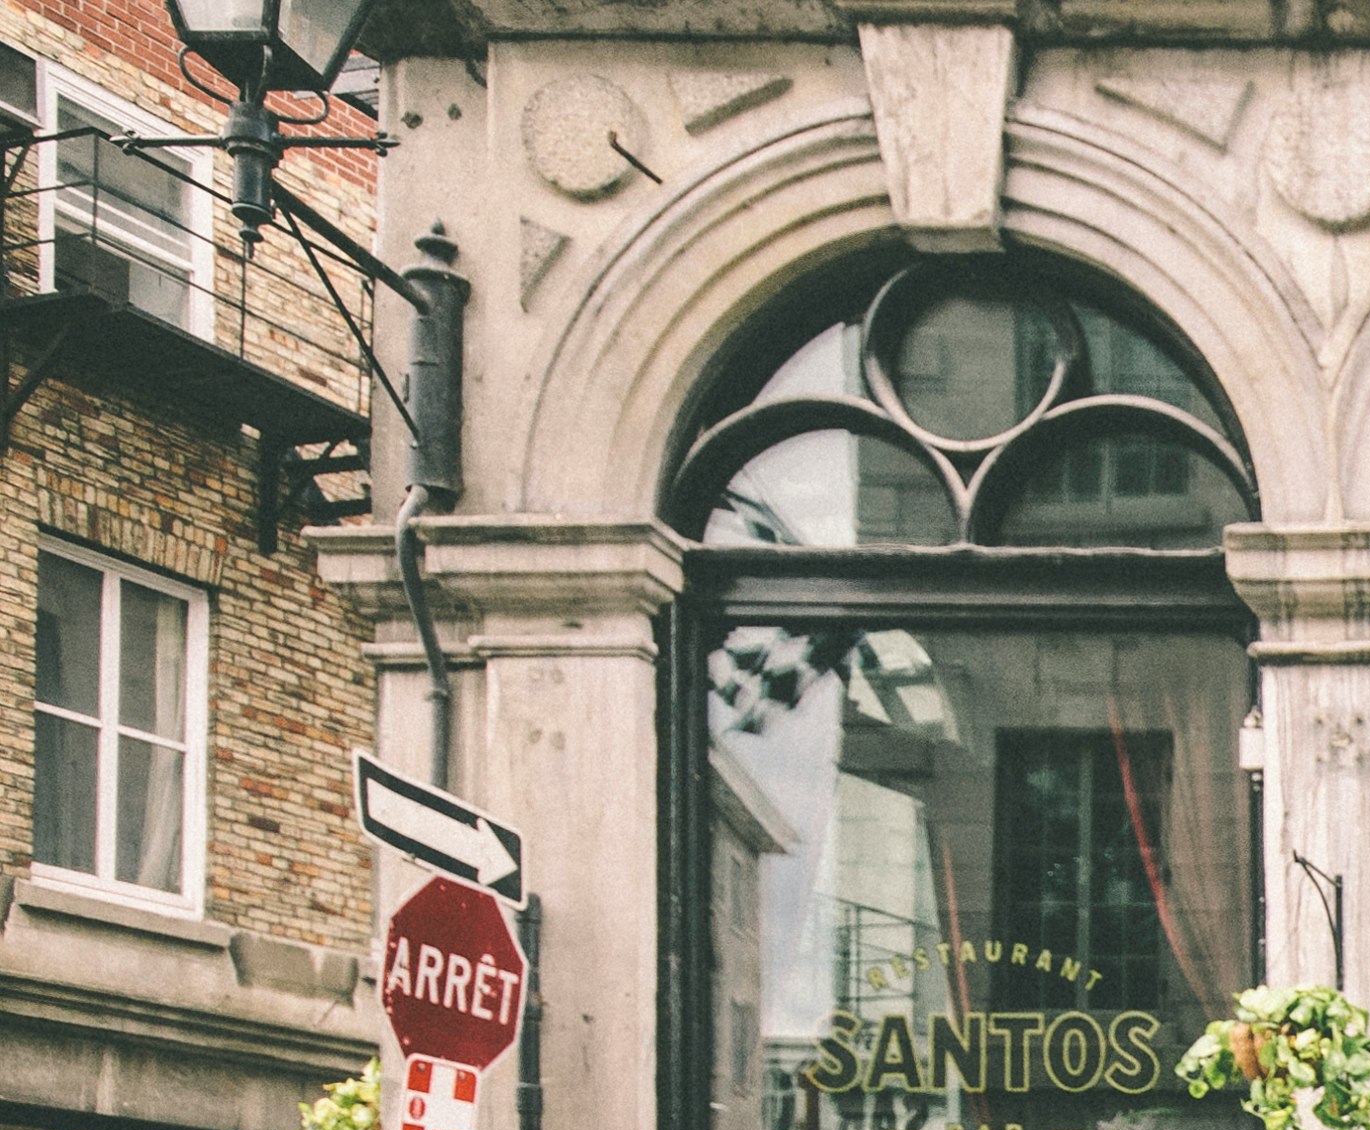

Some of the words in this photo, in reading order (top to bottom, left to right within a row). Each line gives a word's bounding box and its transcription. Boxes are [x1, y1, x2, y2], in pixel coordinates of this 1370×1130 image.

[388, 936, 520, 1026] ARRÊT
[865, 940, 1103, 992] RESTAURANT
[806, 1010, 1161, 1094] SANTOS
